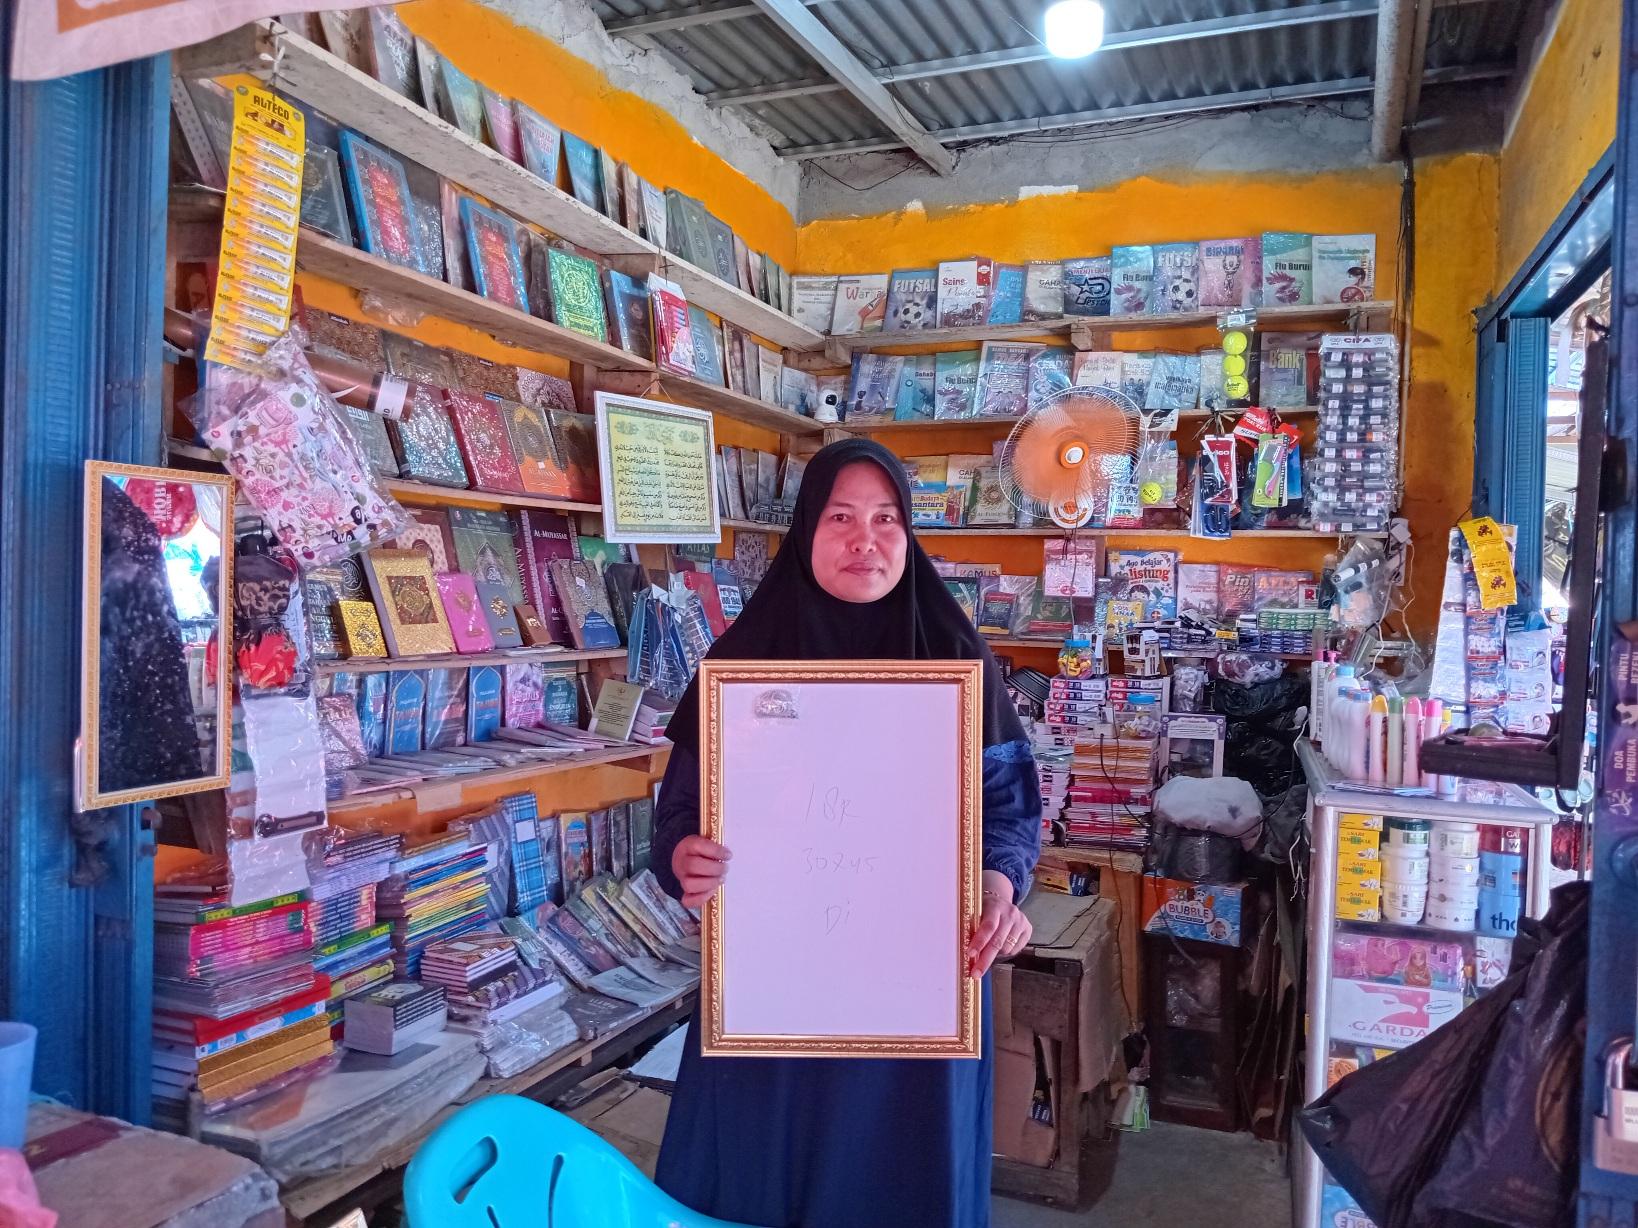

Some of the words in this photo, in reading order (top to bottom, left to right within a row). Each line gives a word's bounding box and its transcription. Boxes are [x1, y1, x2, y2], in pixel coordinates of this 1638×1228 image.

[253, 95, 290, 120] ALTECO
[893, 279, 937, 292] FUTSAL
[942, 277, 966, 286] Sains
[1343, 336, 1371, 344] CIFA
[1270, 350, 1300, 369] Bank
[1618, 653, 1630, 680] PINTU
[1613, 750, 1625, 769] DOA
[1625, 738, 1637, 783] PEMBUKA
[1351, 1020, 1428, 1038] GARDA
